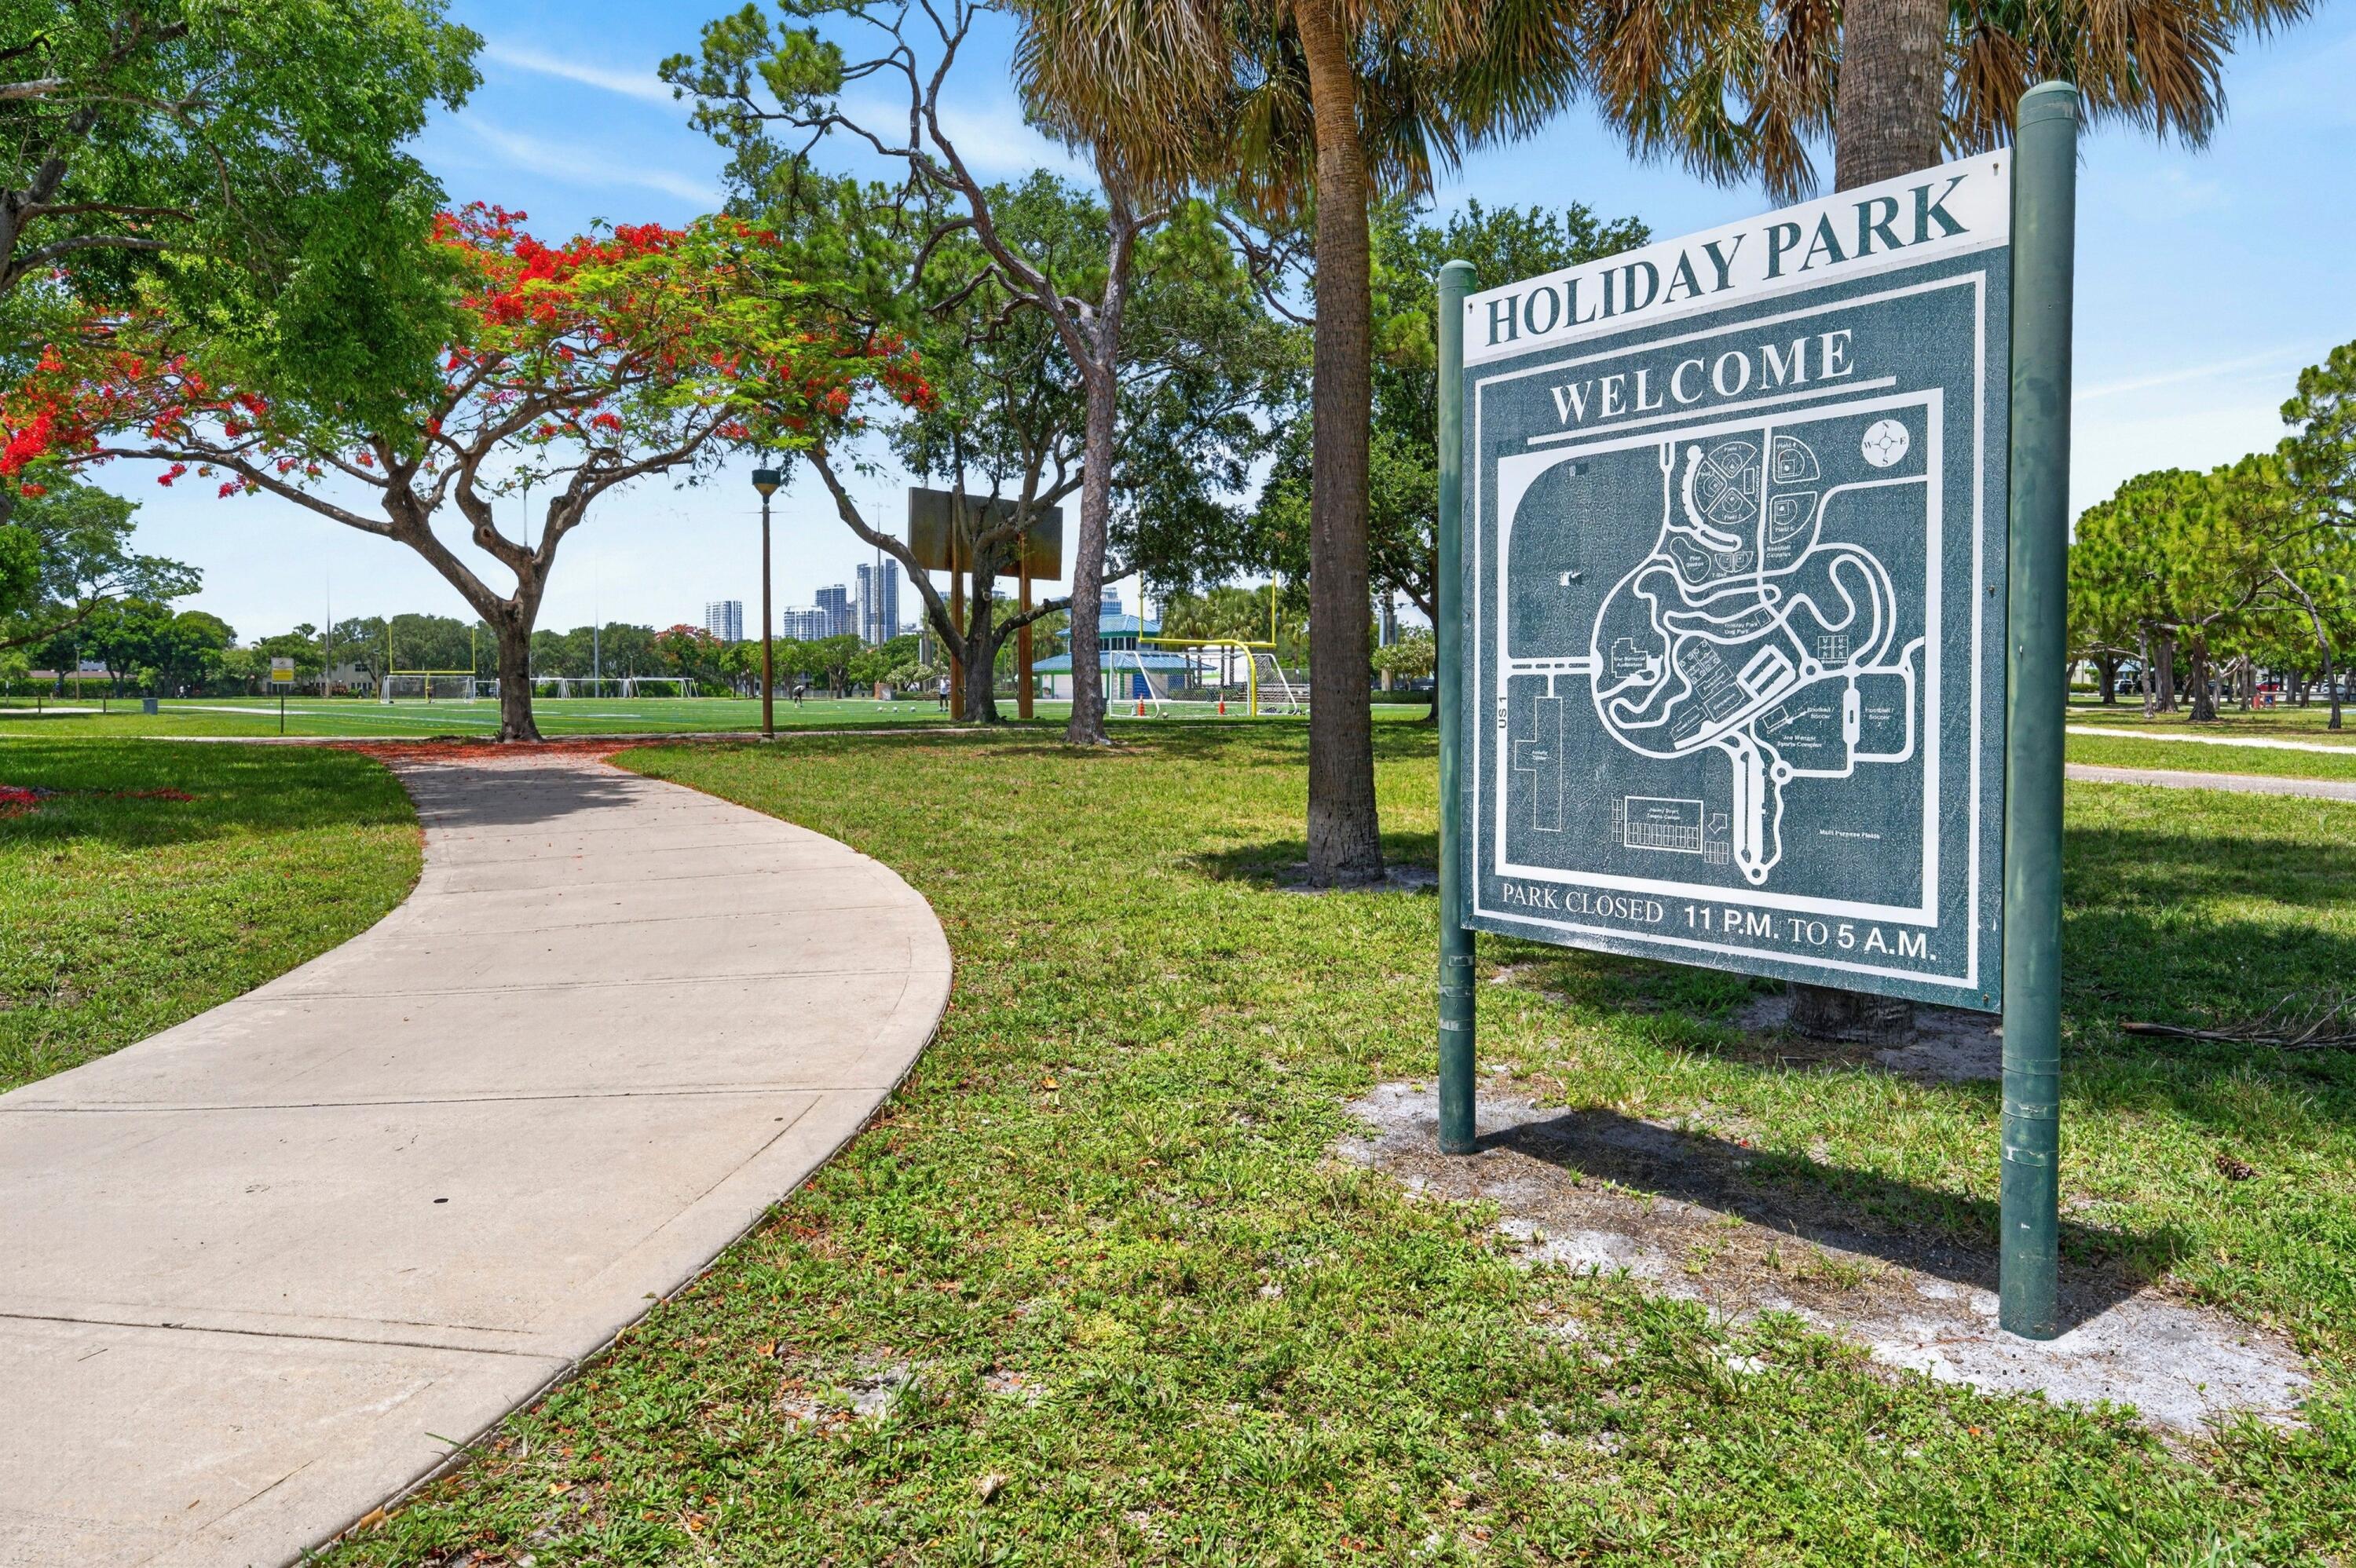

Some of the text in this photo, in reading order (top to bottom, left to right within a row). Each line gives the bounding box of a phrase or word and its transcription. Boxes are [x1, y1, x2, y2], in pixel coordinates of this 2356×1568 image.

[1486, 174, 1970, 346] HOLIDAY PARK
[1550, 329, 1853, 425] WELCOME
[1498, 708, 1507, 729] US
[1503, 883, 1937, 960] PARK CLOSED 11 P.M. TO 5 A.M.
